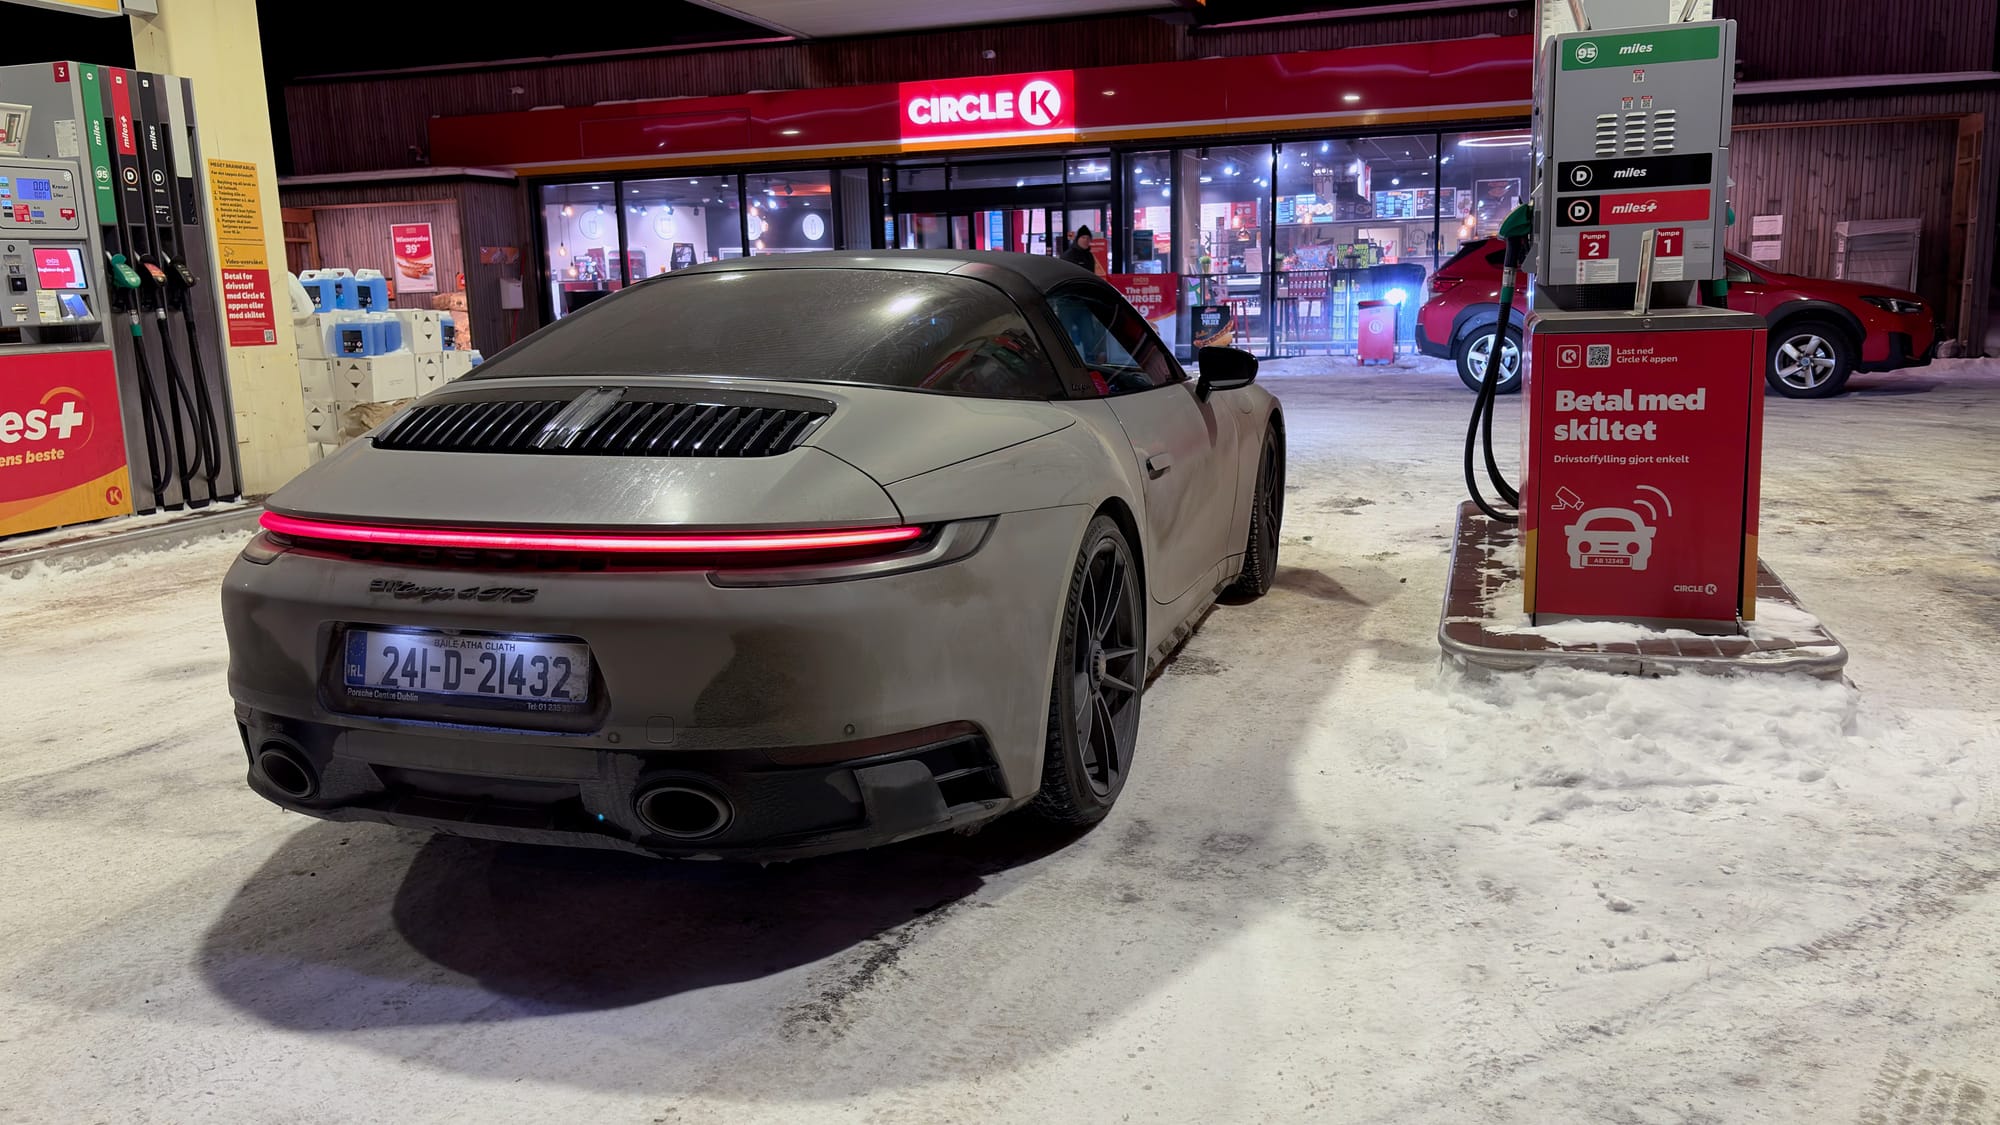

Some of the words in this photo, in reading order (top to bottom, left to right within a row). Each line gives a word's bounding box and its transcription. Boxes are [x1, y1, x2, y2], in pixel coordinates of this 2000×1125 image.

[1578, 47, 1596, 59] 95
[1619, 43, 1653, 54] miles
[58, 67, 65, 78] 3
[908, 92, 1014, 124] CIRCLE
[1025, 85, 1058, 124] K
[121, 116, 130, 148] miles+
[96, 170, 108, 179] 95
[1576, 170, 1587, 182] D
[1614, 168, 1647, 178] miles
[1574, 206, 1585, 216] D
[1612, 202, 1657, 214] miles+
[1588, 242, 1599, 256] 2
[1664, 239, 1671, 253] 1
[1126, 294, 1162, 303] URGER
[1650, 356, 1678, 364] appen
[1556, 389, 1634, 412] Betal
[1638, 388, 1706, 411] med
[1554, 417, 1656, 441] skiltet
[26, 448, 64, 463] beste
[1554, 454, 1626, 464] Drivstoffylling
[1628, 455, 1654, 464] gjort
[1656, 455, 1689, 463] enkelt
[108, 488, 122, 504] K
[478, 587, 538, 602] GTS
[1706, 585, 1716, 594] K
[434, 639, 458, 648] BAILE
[485, 642, 515, 652] CLIATH
[347, 664, 363, 677] IRL
[381, 646, 571, 698] 241-D-21432
[347, 688, 373, 698] Porsche
[374, 690, 396, 700] Centre
[397, 692, 419, 702] Dublin
